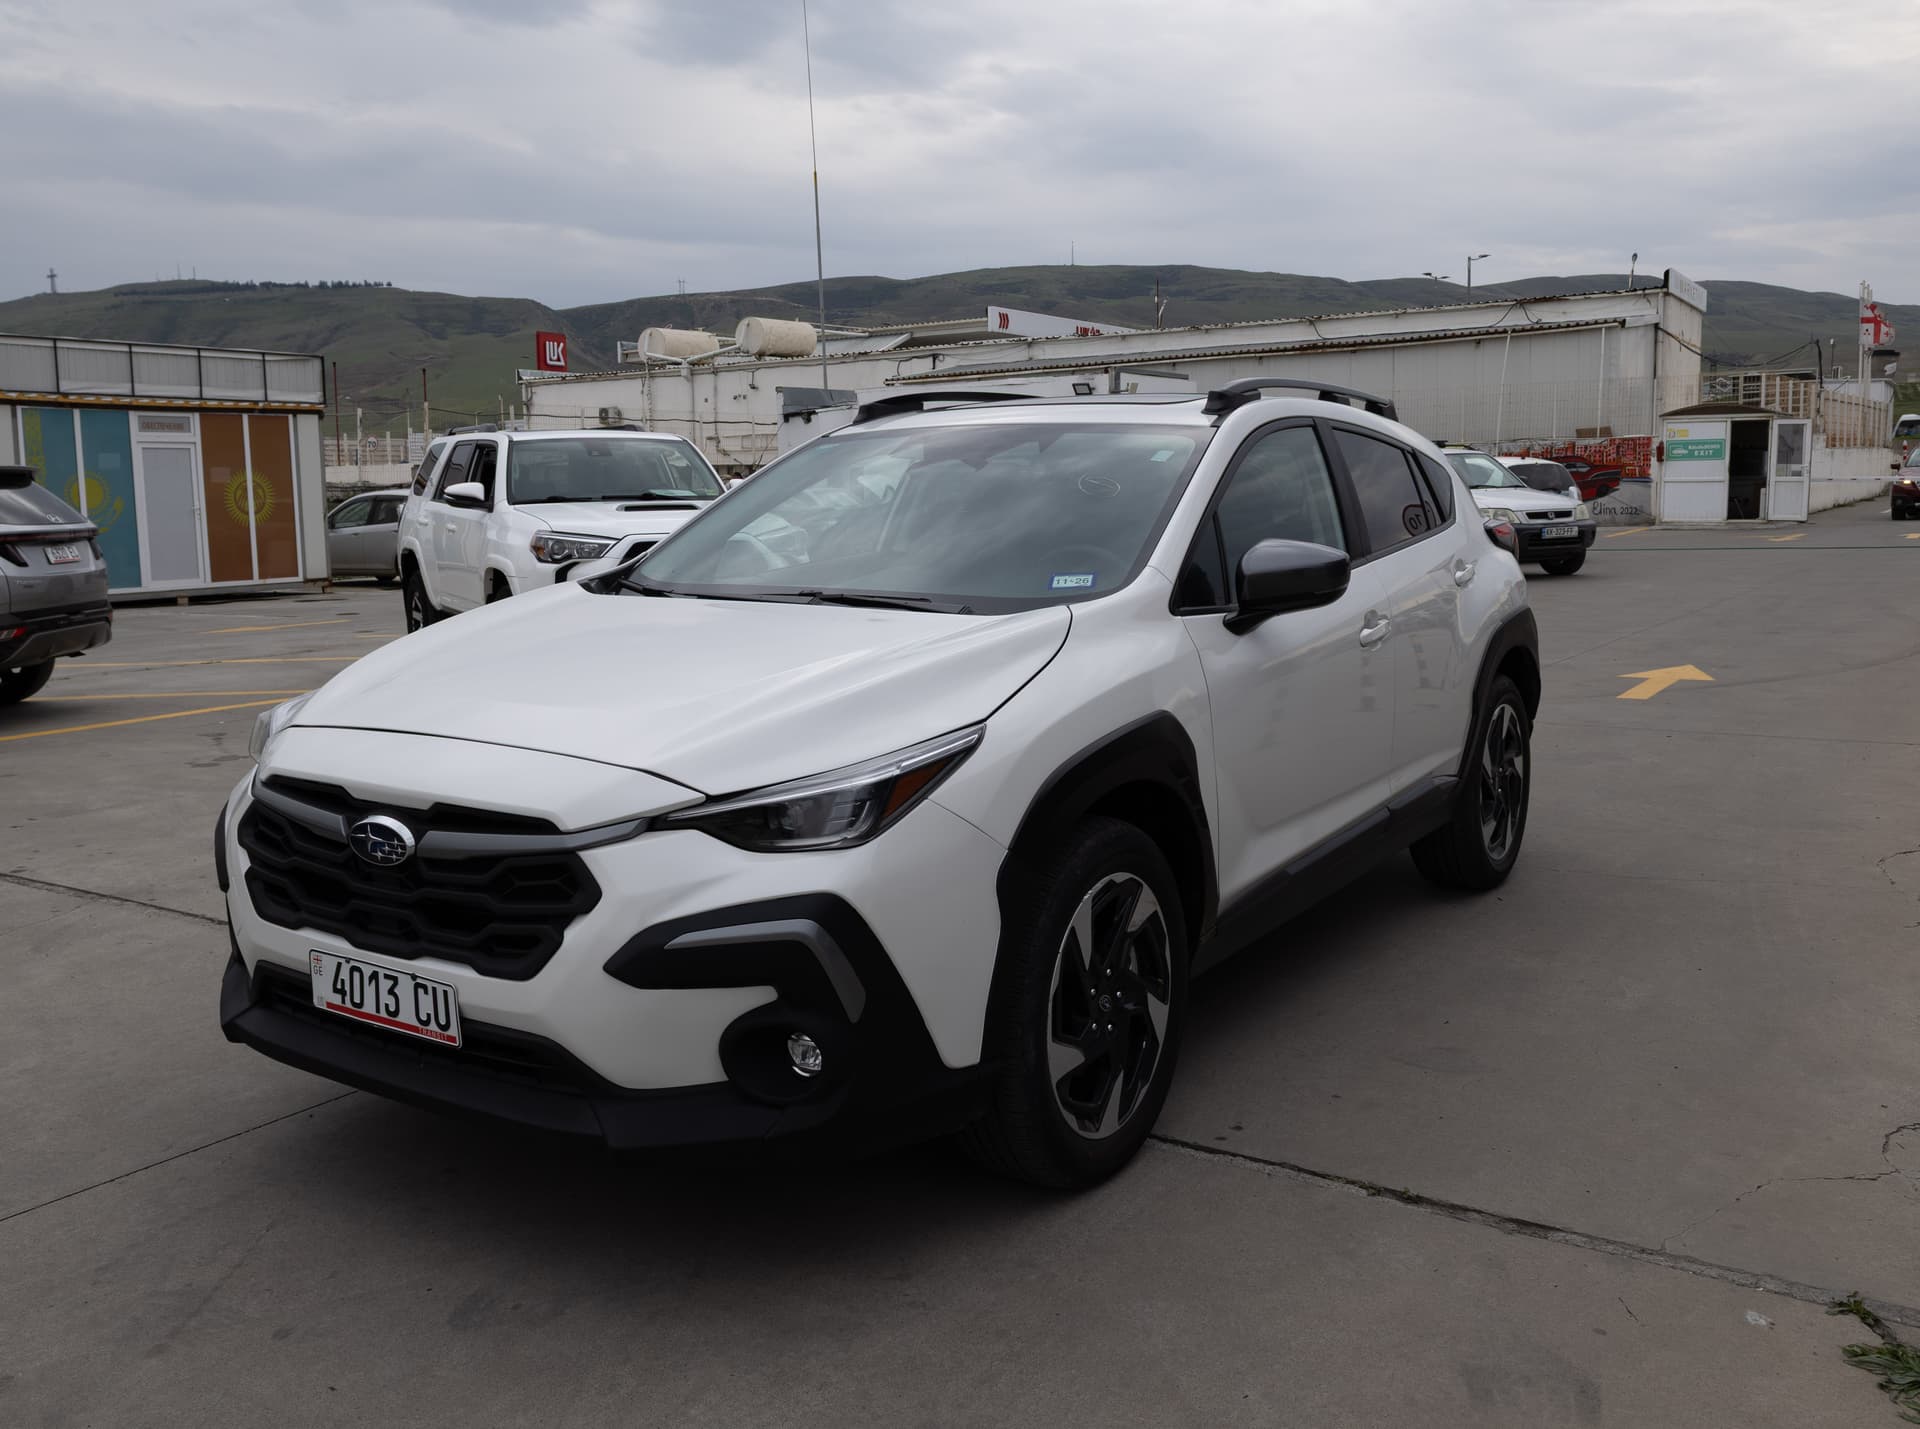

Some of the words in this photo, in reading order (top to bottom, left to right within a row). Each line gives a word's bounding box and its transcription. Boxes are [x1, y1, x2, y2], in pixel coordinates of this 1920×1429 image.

[367, 440, 377, 449] 70
[313, 965, 323, 976] GE
[332, 961, 401, 1018] 4013
[413, 981, 451, 1032] CU
[418, 1026, 449, 1042] TRANSIT
